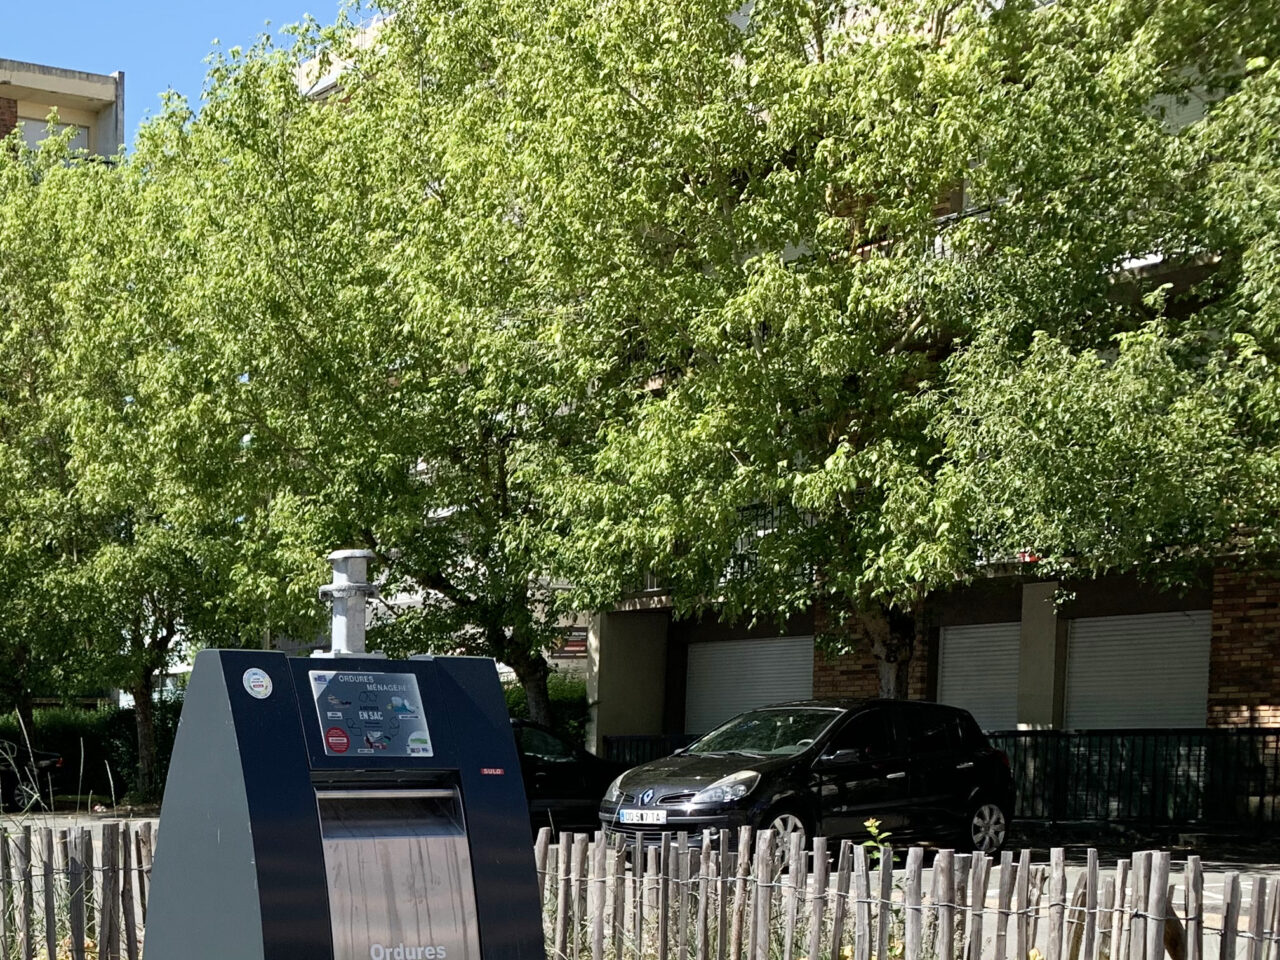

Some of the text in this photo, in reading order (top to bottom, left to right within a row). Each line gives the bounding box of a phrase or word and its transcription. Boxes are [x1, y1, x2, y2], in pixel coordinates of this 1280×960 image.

[338, 675, 374, 684] ORDURES
[359, 711, 384, 721] EN SAC
